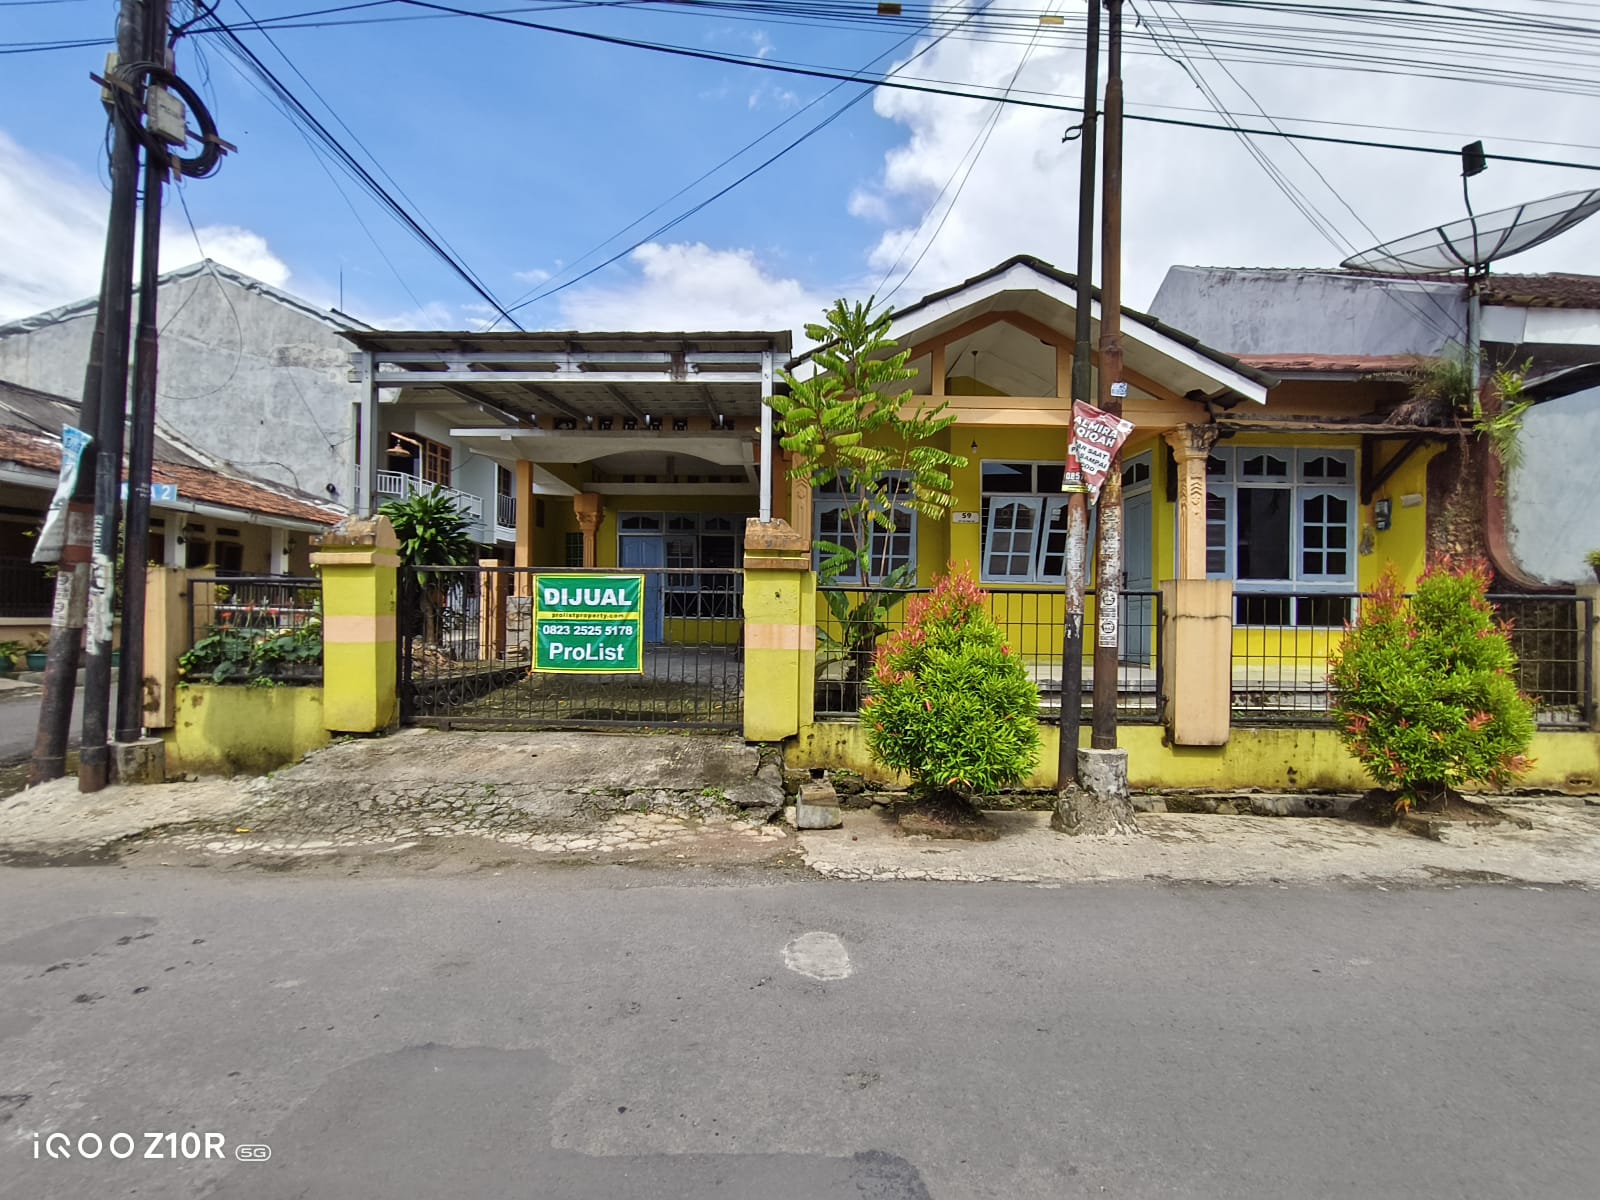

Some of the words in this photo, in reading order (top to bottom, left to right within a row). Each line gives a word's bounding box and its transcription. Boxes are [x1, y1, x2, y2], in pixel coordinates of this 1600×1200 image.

[1074, 415, 1118, 438] ALMIRA
[1080, 453, 1107, 469] SAMPAI
[1088, 448, 1109, 460] SAAT
[161, 485, 171, 500] 2
[543, 587, 632, 606] DIJUAL
[543, 625, 570, 635] 0823
[574, 625, 602, 636] 2525
[605, 626, 633, 636] 5178
[549, 642, 625, 661] ProList
